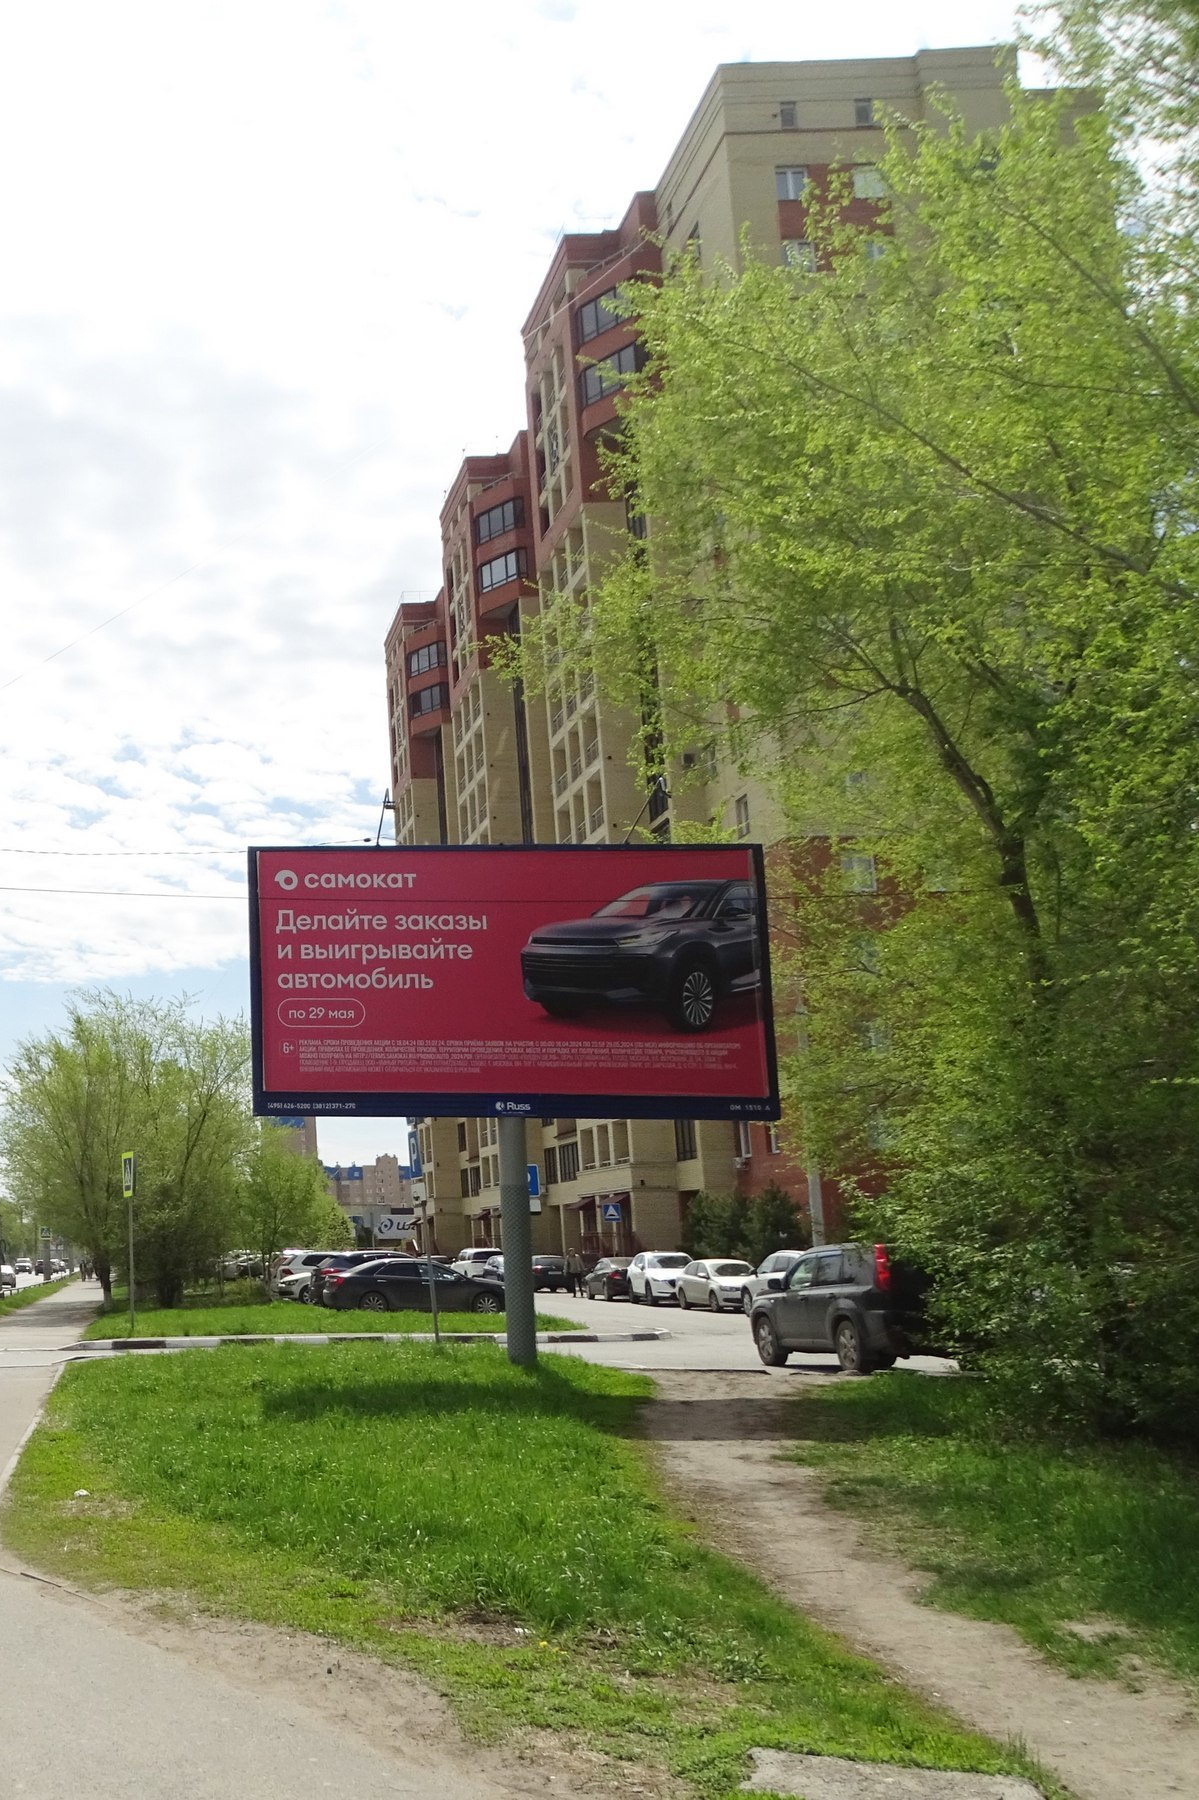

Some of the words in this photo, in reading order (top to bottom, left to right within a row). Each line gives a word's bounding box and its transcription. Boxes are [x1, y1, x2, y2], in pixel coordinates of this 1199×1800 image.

[304, 872, 417, 889] самокат
[275, 908, 388, 934] Делайте
[394, 914, 488, 931] заказы
[277, 944, 293, 960] и
[300, 937, 473, 965] выигрывайте
[277, 967, 434, 990] автомобиль
[288, 1009, 306, 1020] по
[308, 1007, 325, 1019] 29
[328, 1009, 355, 1019] мая
[282, 1042, 295, 1054] 6+
[506, 1101, 531, 1110] Russ
